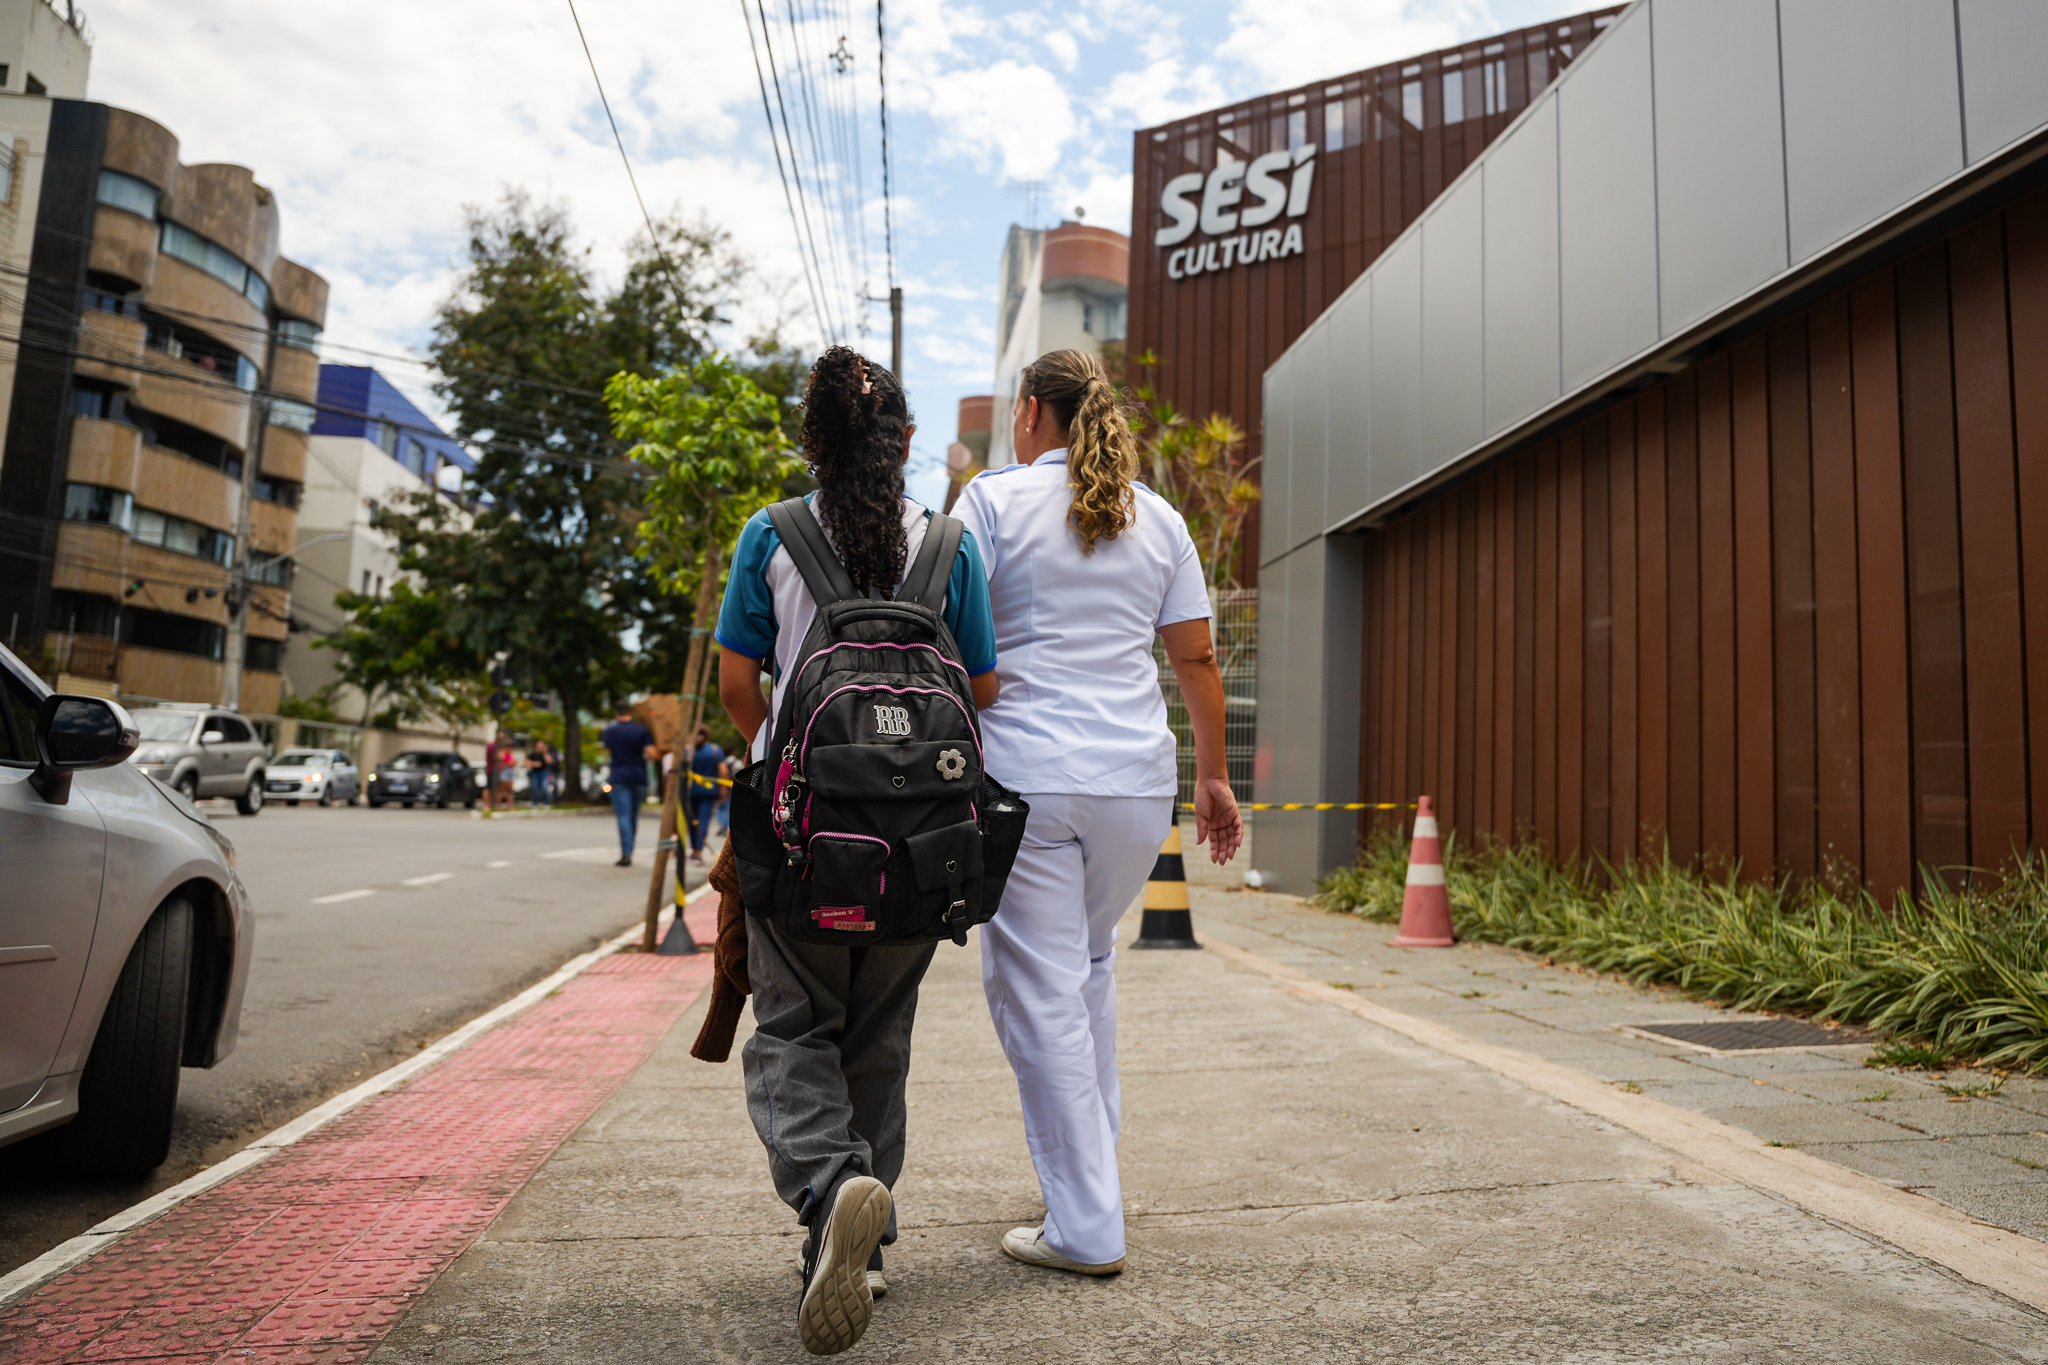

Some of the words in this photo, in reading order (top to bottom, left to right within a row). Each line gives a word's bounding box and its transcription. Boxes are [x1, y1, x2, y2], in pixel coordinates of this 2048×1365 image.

[1155, 143, 1316, 247] SESI
[1167, 223, 1303, 280] CULTURA
[873, 704, 911, 736] RB
